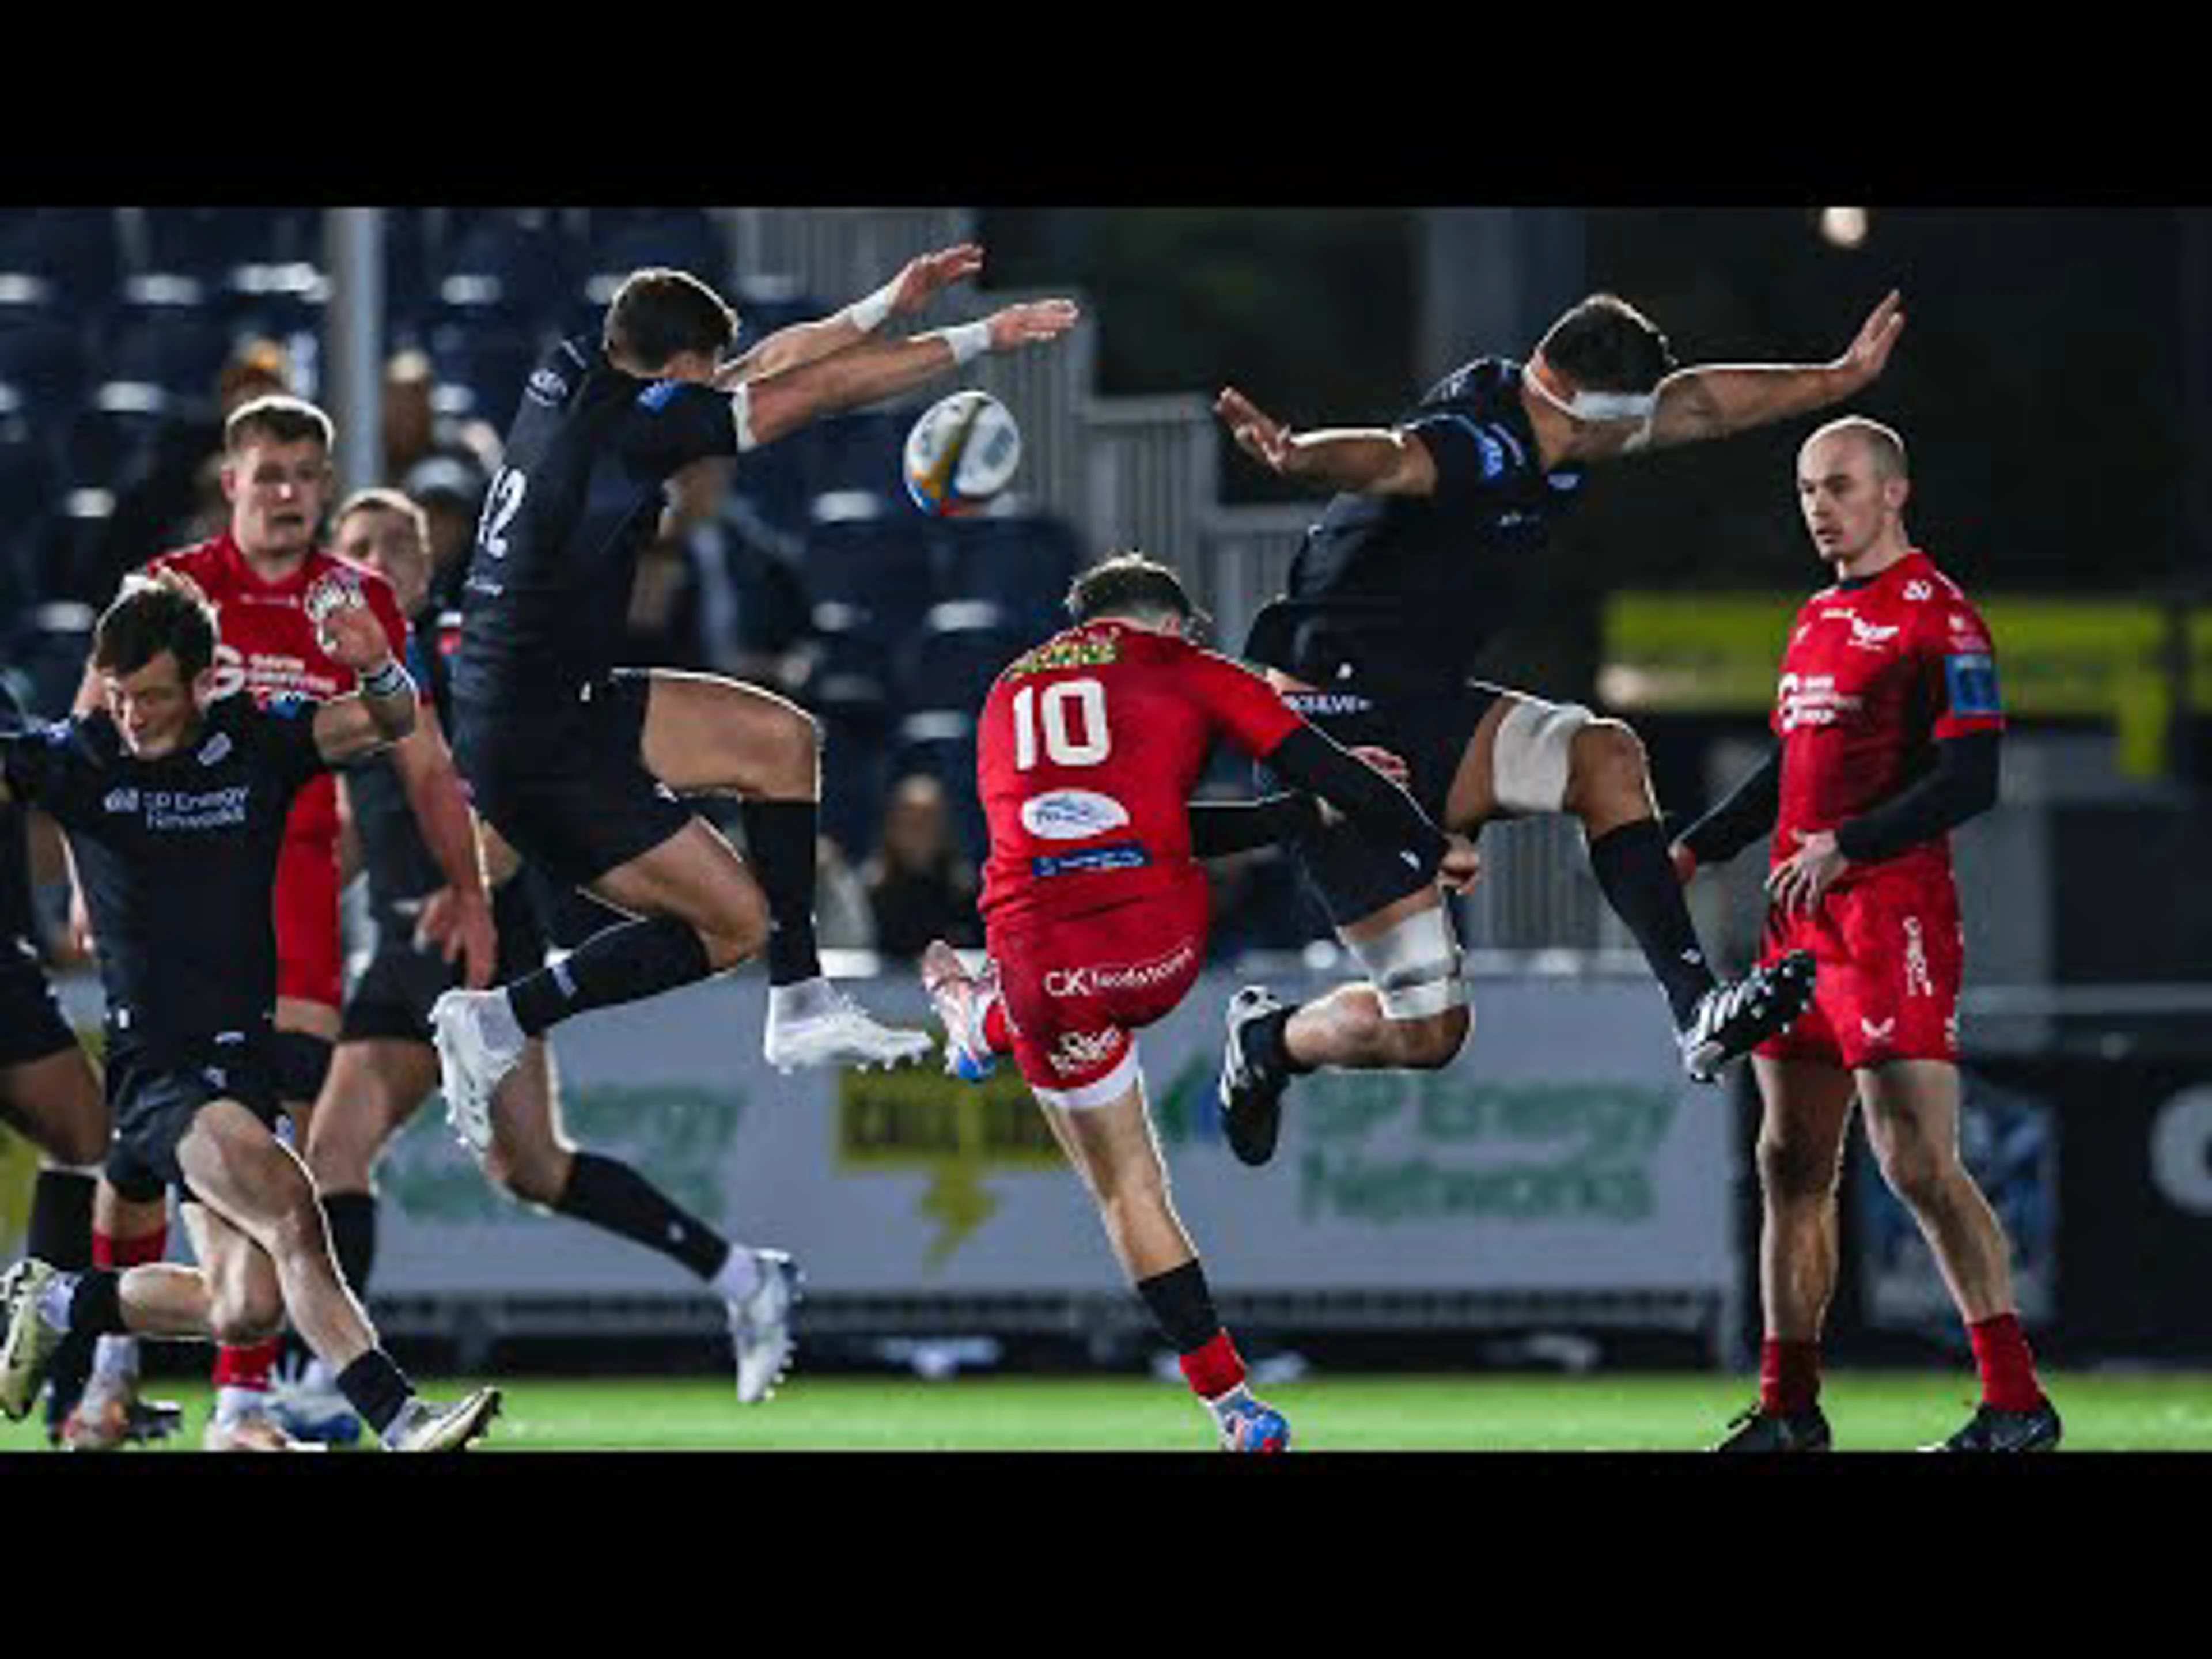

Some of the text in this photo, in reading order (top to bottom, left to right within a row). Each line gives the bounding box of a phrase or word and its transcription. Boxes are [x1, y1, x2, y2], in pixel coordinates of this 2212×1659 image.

[1012, 679, 1112, 772] 10
[1041, 966, 1090, 997] CK
[1418, 1076, 1677, 1159] Energy
